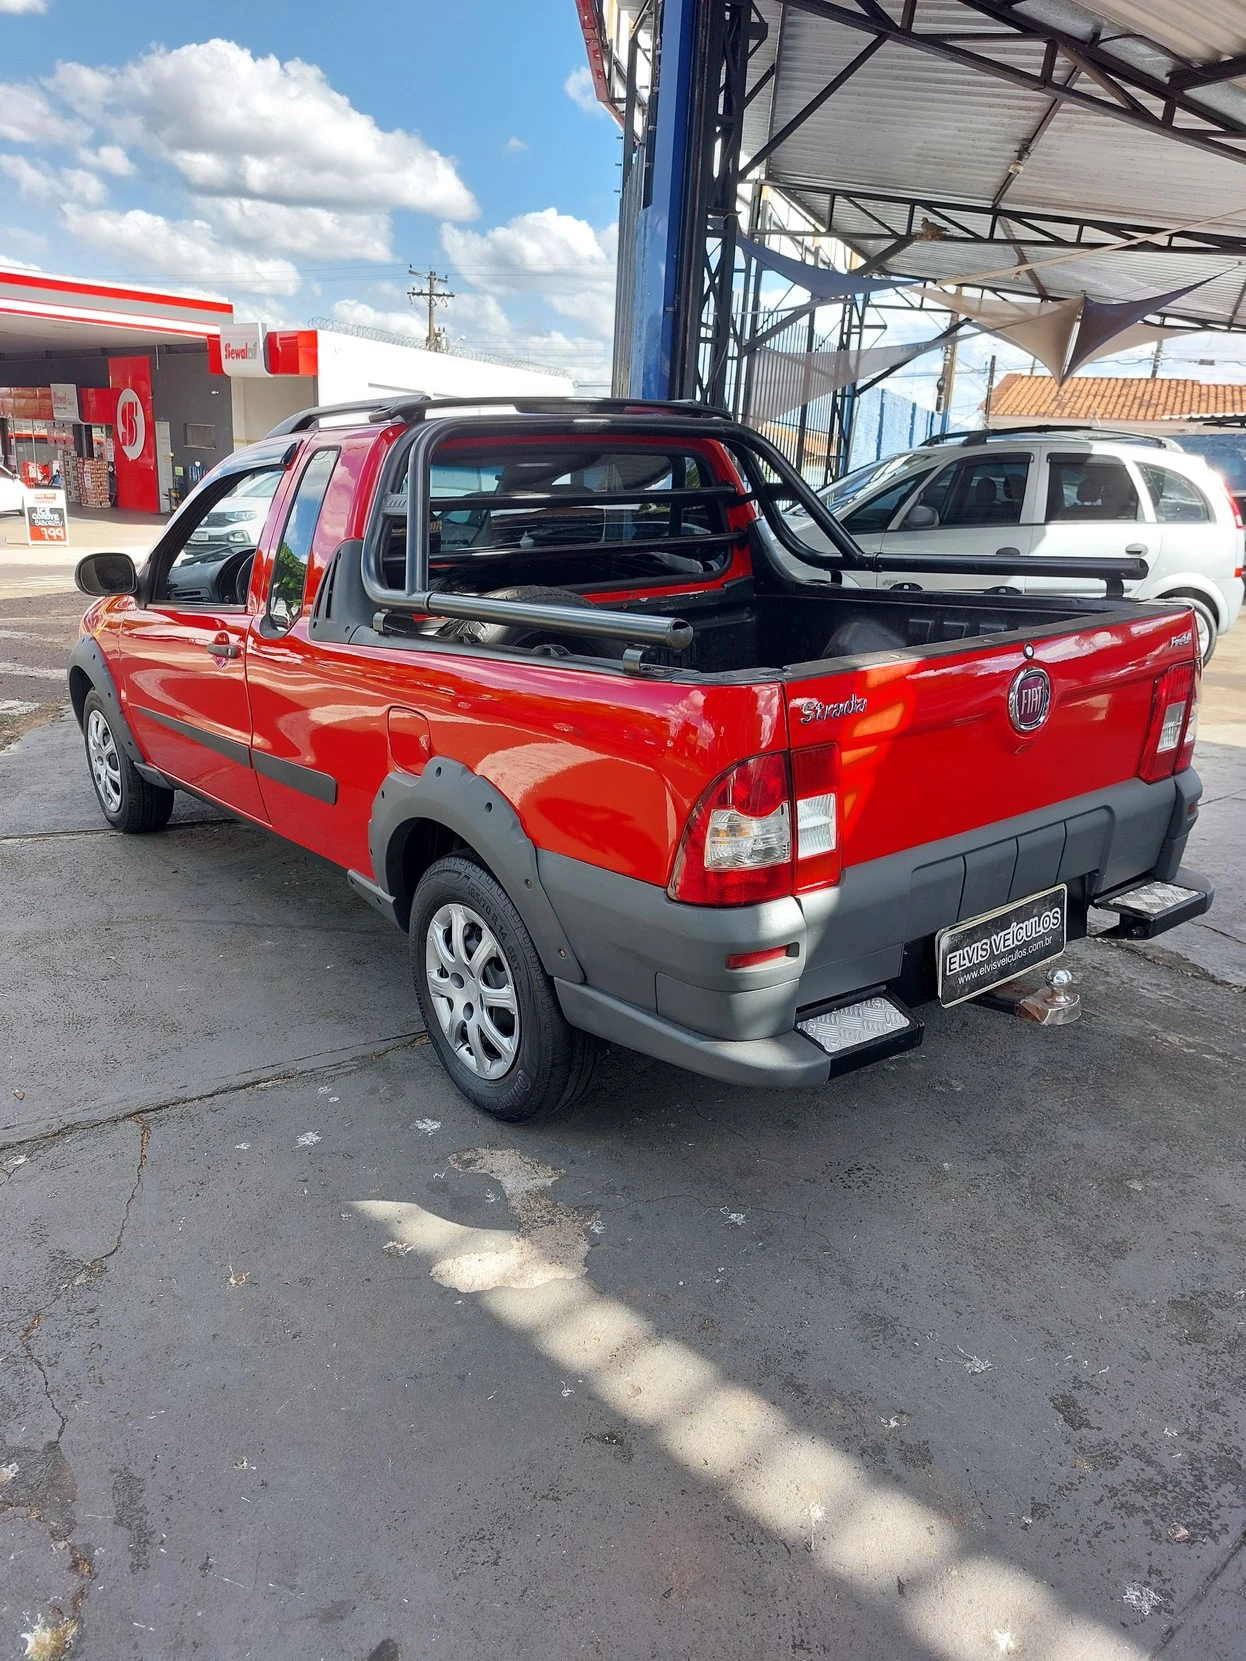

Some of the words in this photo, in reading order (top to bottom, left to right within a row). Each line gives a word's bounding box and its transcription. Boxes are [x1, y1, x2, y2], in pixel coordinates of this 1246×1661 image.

[800, 694, 867, 724] Strada
[1020, 686, 1043, 716] FIAT
[946, 938, 991, 976] ELVIS
[991, 907, 1061, 955] VEÍCULOS
[957, 935, 1053, 985] www.elvisveiculos.com.br
